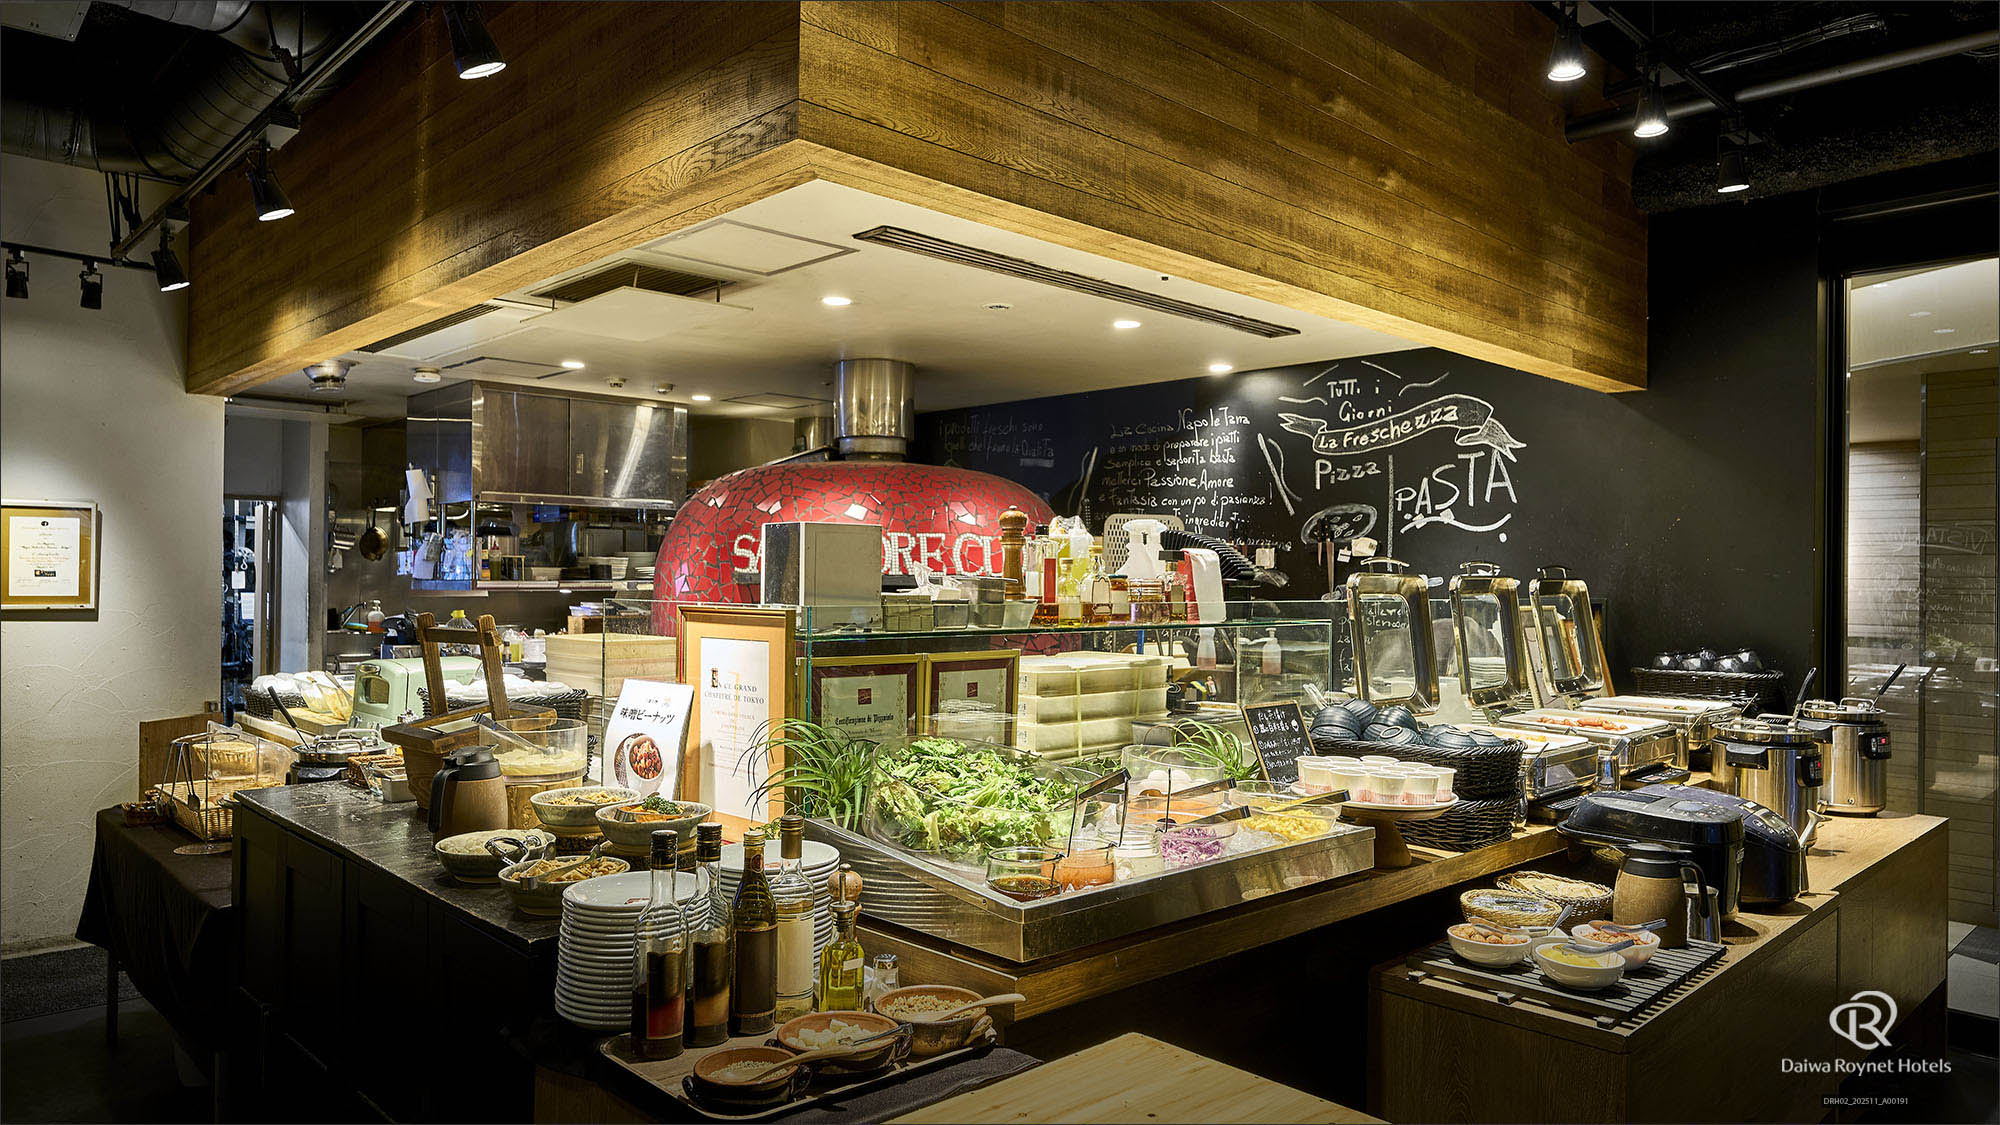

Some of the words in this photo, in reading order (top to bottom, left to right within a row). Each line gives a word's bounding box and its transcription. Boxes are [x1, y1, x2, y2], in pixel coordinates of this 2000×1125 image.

[1339, 400, 1392, 422] Giorni
[1318, 432, 1338, 450] La
[1315, 459, 1382, 490] Pizza
[1395, 449, 1518, 514] PASTA
[734, 683, 757, 693] GRAND
[743, 695, 765, 705] TOKYO
